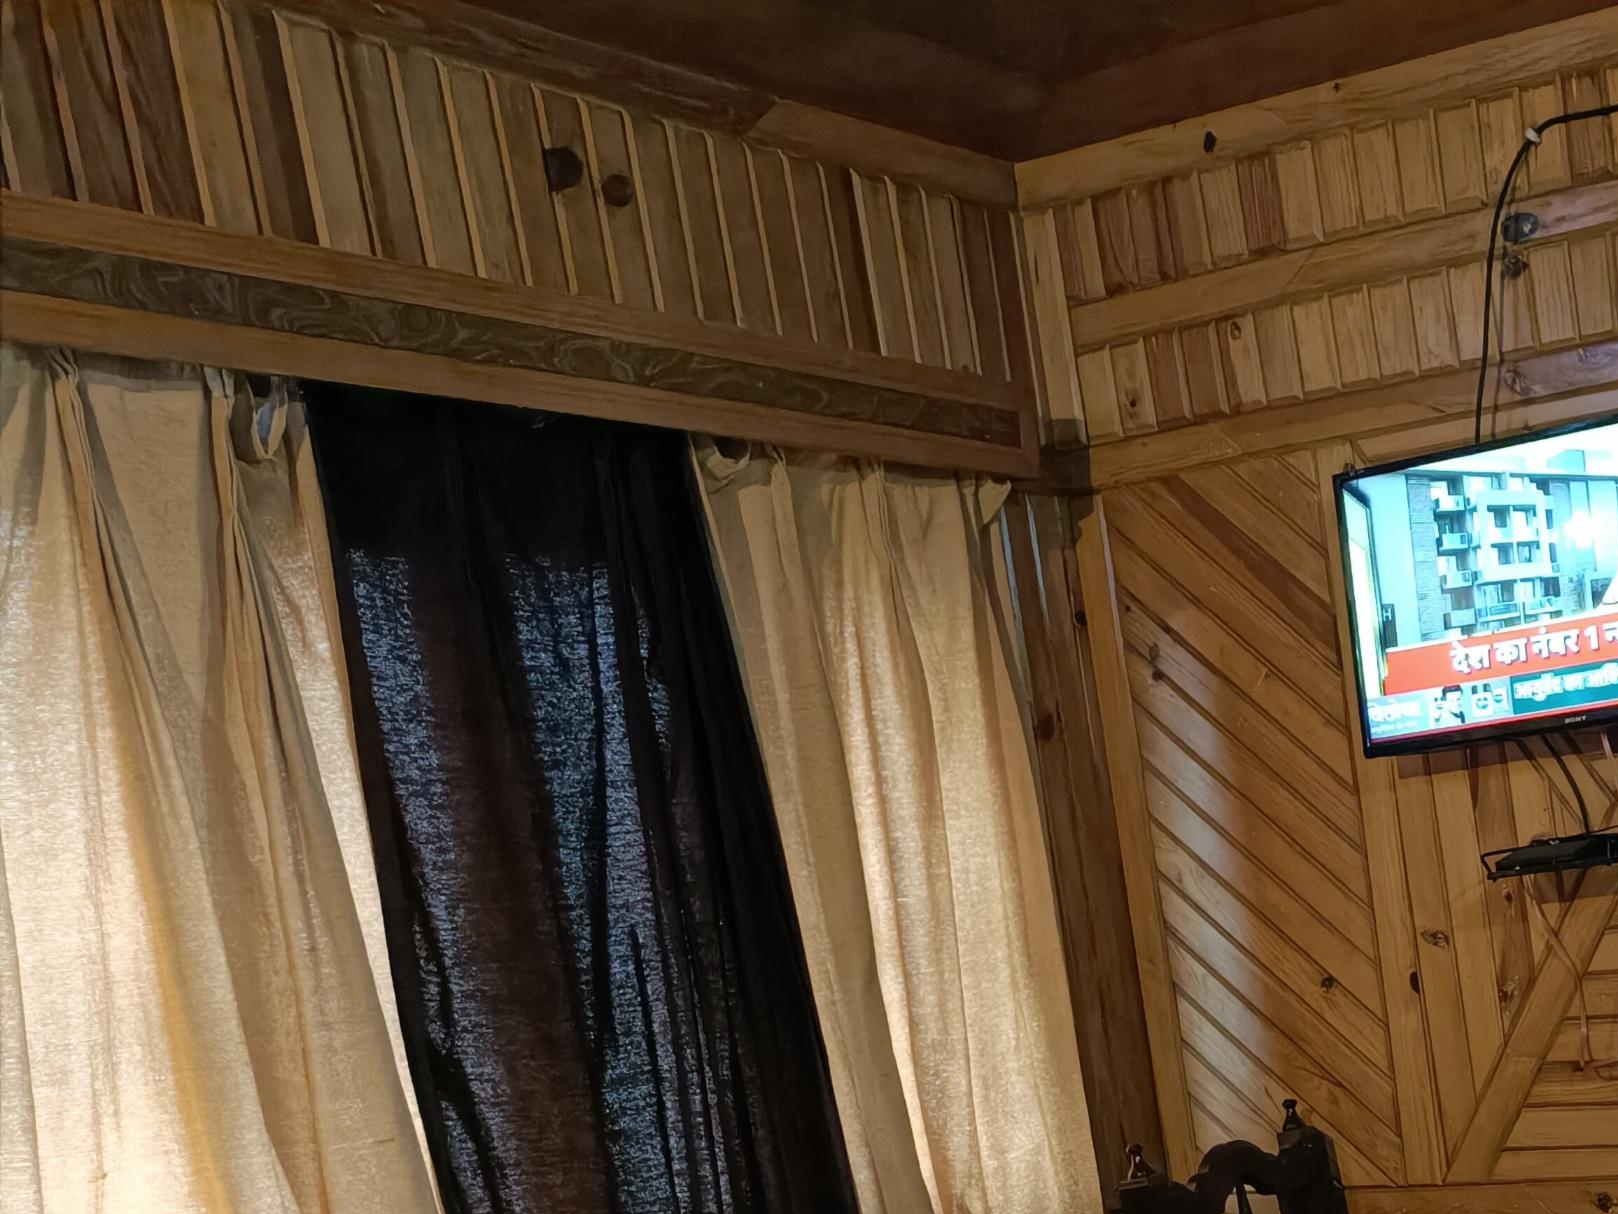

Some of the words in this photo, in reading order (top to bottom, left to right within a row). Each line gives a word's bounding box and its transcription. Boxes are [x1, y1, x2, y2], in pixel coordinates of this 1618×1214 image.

[1450, 640, 1491, 674] देश
[1493, 637, 1528, 665] का
[1530, 626, 1580, 659] नंबर
[1584, 625, 1600, 650] 1
[1565, 715, 1587, 725] SONY
